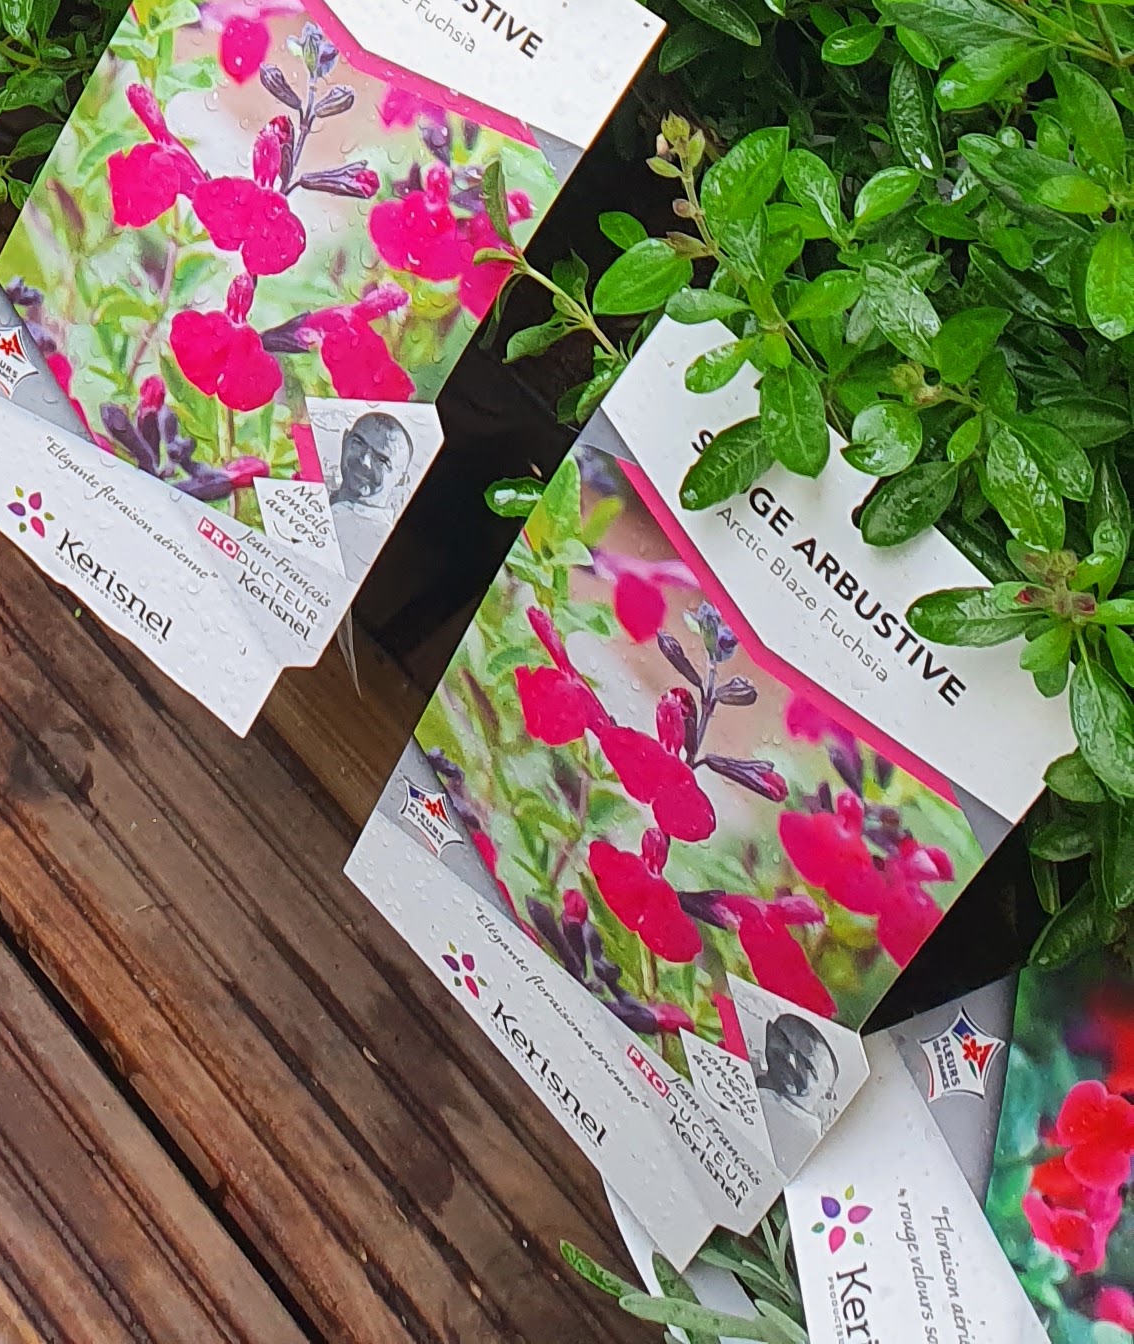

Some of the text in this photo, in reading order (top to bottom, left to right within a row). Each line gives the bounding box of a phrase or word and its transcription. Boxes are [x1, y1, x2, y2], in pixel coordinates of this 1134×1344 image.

[94, 485, 154, 535] floraison
[265, 498, 326, 550] au verso
[274, 488, 332, 536] conseils
[293, 485, 326, 514] Mes
[55, 527, 173, 642] Kerisnel
[197, 516, 319, 625] PRODUCTEUR
[236, 529, 332, 608] Jean-François
[691, 429, 967, 708] SGE ARBUSTIVE
[716, 506, 889, 683] Arctic Blaze Fuchsia
[237, 570, 312, 642] Kerisnel
[490, 998, 608, 1147] Kerisnel
[692, 1054, 755, 1127] au verso
[700, 1046, 758, 1114] conseils
[719, 1055, 754, 1091] Mes
[940, 1035, 961, 1087] FLEURS
[626, 1044, 749, 1197] PRODUCTEUR
[668, 1111, 743, 1210] Kerisnel
[910, 1255, 935, 1321] velours
